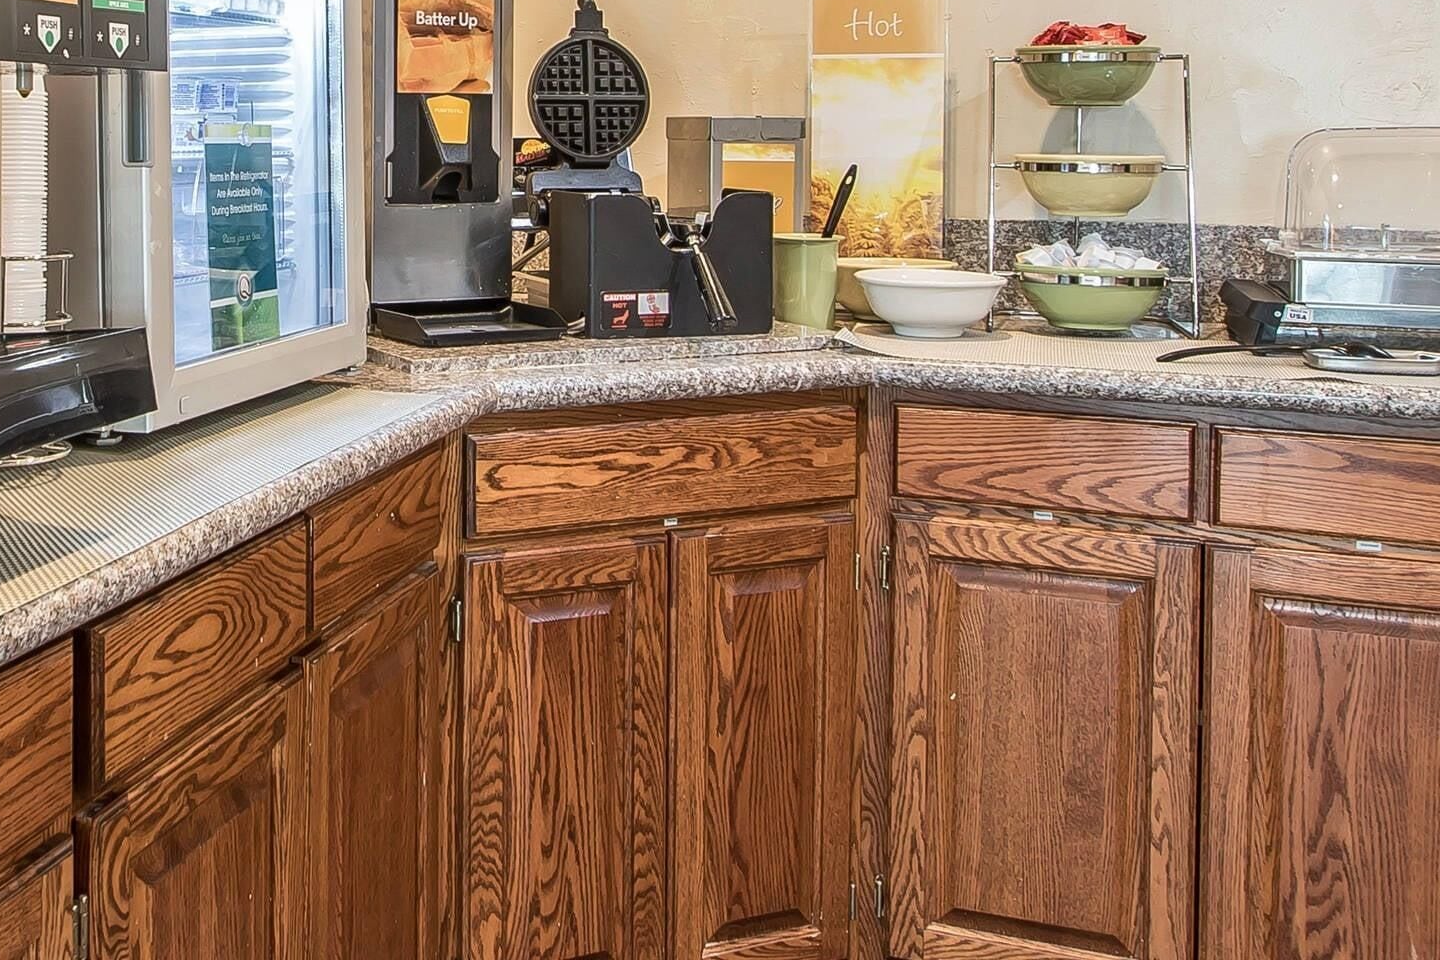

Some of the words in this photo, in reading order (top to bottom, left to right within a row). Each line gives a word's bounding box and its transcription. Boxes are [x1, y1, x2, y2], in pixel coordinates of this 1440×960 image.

[40, 19, 58, 29] PUSH
[416, 10, 456, 26] Batter
[459, 12, 478, 30] Up
[844, 8, 903, 41] Hot
[112, 27, 127, 36] PUSH
[604, 294, 636, 302] CAUTION
